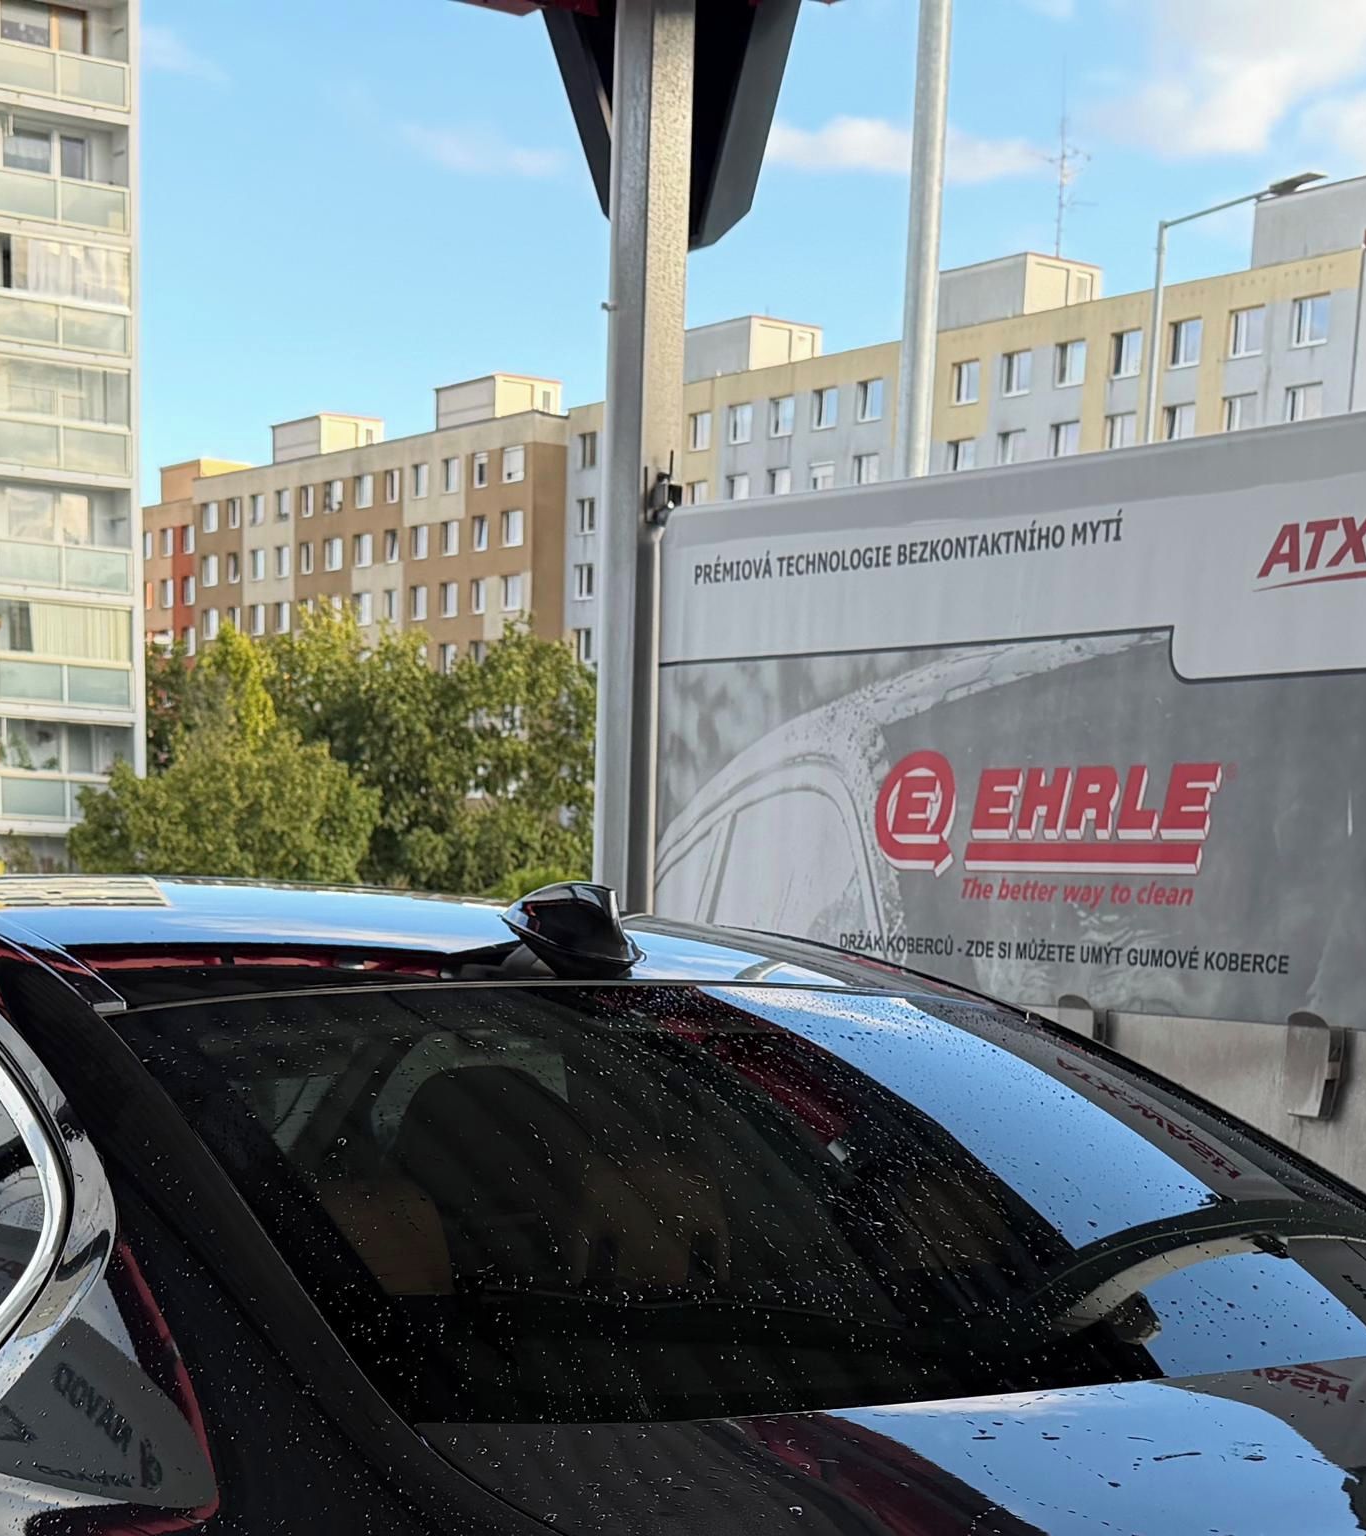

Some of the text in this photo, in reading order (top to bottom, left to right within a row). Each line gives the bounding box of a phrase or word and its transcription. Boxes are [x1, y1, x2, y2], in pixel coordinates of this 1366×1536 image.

[693, 508, 1123, 585] PRÉMIOVÁ TECHNOLOGIE BEZKONTAKTNÍHO MYTÍ
[970, 761, 1223, 841] EHRLE
[960, 877, 1194, 910] The better way to clean
[839, 929, 884, 951] DRŽÁK
[886, 934, 954, 956] KOBERCŮ
[965, 940, 994, 958] ZDE
[998, 942, 1011, 960] SI
[1015, 938, 1075, 963] MŮŽETE
[1079, 941, 1122, 966] UMÝT
[1127, 945, 1200, 970] GUMOVÉ
[1204, 951, 1290, 975] KOBERCE
